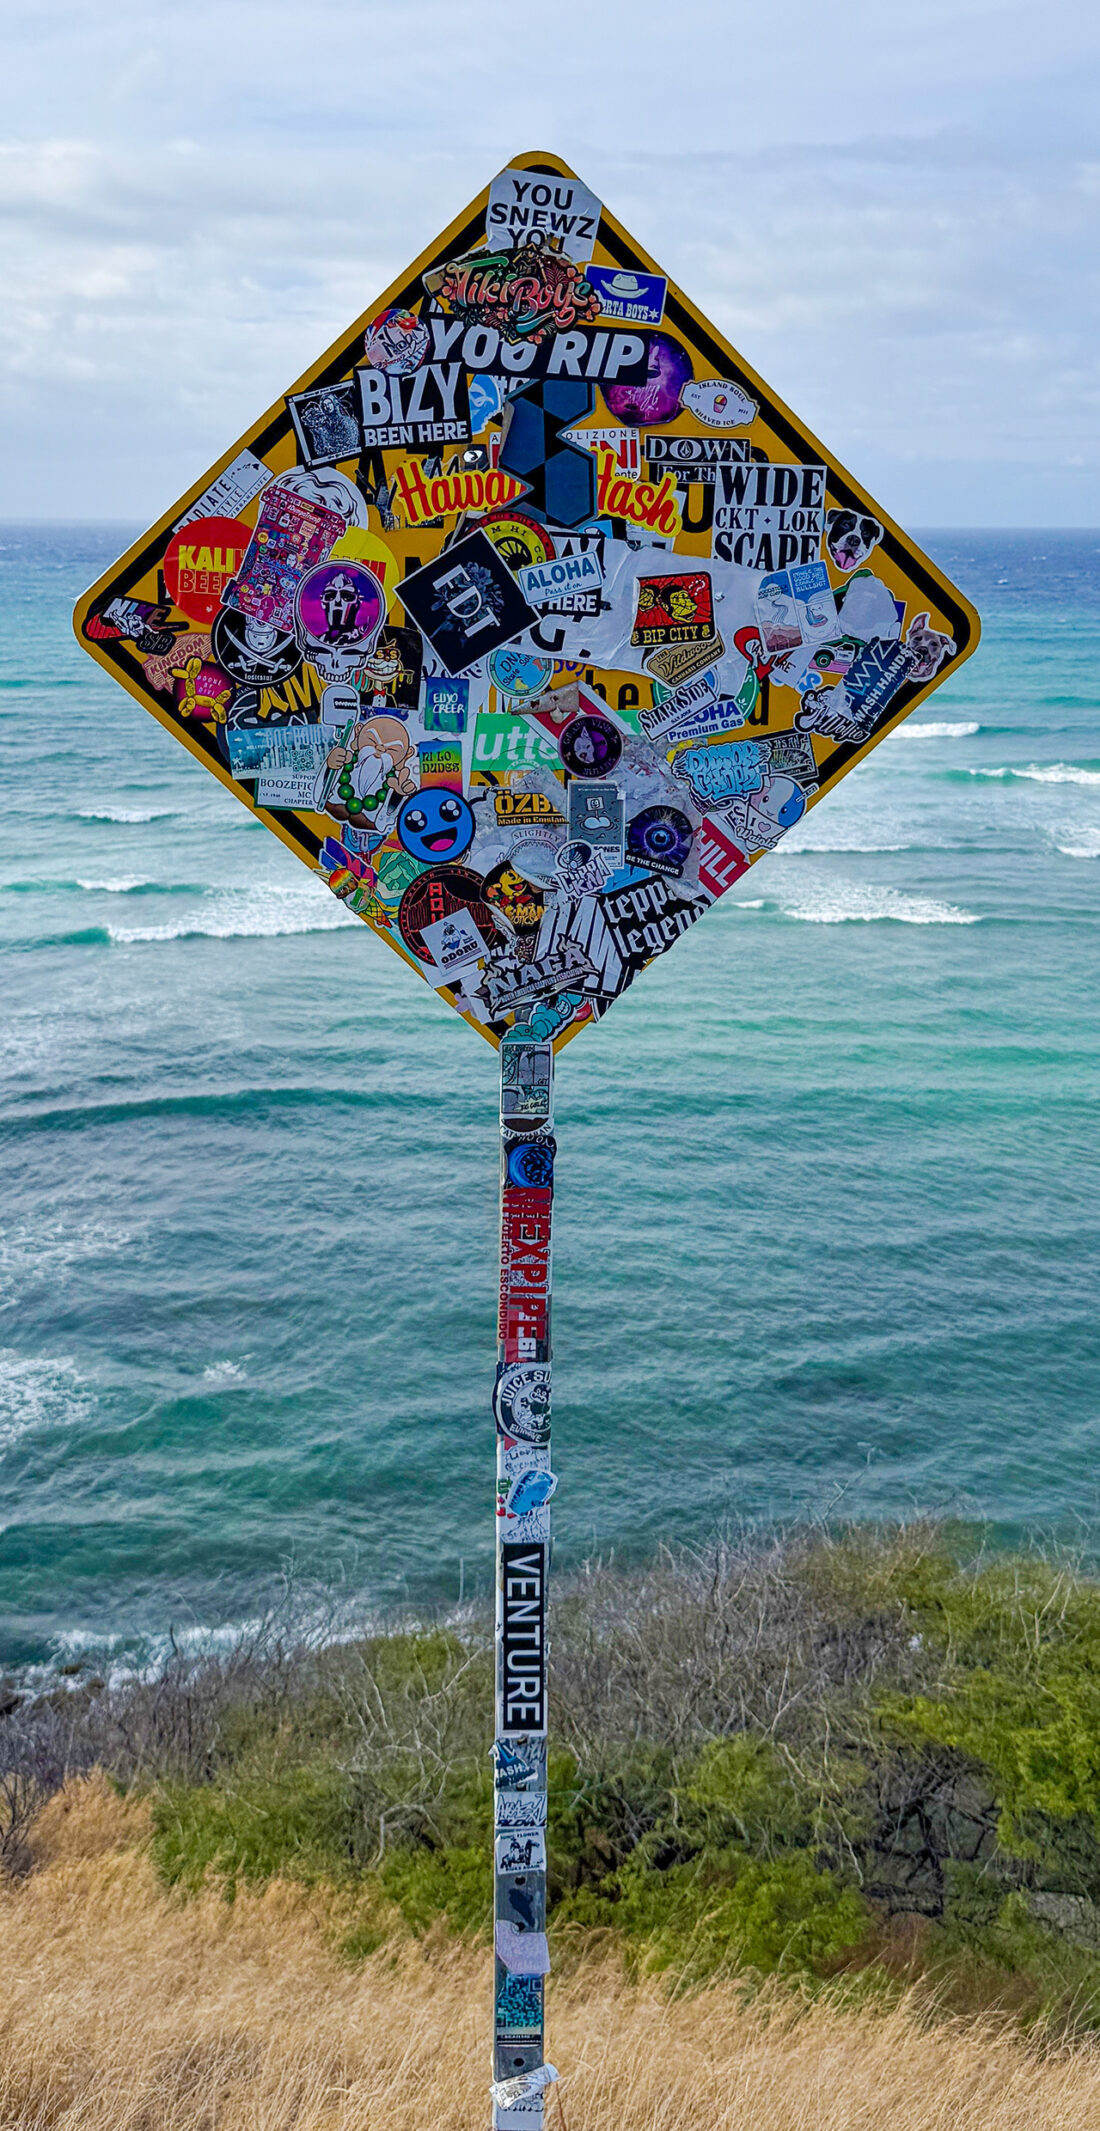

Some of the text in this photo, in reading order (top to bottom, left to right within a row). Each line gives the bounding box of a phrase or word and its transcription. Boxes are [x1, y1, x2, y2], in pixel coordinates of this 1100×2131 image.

[512, 179, 573, 210] YOU
[489, 202, 595, 240] SNEWZ
[625, 303, 650, 321] BOYS
[430, 318, 645, 379] YOU RIP
[357, 361, 463, 427] BIZY
[699, 381, 746, 402] ISLAND SOUL
[694, 408, 721, 425] SHAVED
[364, 420, 469, 447] BEEN HERE
[648, 437, 748, 462] DOWN
[694, 467, 716, 481] Th
[719, 465, 825, 509] WIDE
[178, 477, 232, 532] ADIATE
[396, 461, 528, 523] Hawai
[713, 531, 820, 573] SCAPE
[526, 557, 596, 591] ALOHA
[643, 625, 699, 644] BIP CITY
[150, 638, 205, 675] KINGDOM
[658, 640, 712, 678] Wildwoo
[695, 648, 721, 668] COMPANY
[853, 648, 909, 725] WASH HANDS
[432, 703, 465, 714] CREER
[639, 678, 709, 729] SHARKSIDE
[678, 701, 742, 729] LOHA
[668, 716, 744, 742] Premium Gas
[422, 762, 460, 774] DUDES
[284, 798, 314, 807] CHAPTER
[297, 790, 312, 800] MC
[494, 791, 557, 814] ÖZB
[497, 817, 521, 826] Made
[513, 829, 560, 842] SLIGHTLY
[637, 857, 651, 866] THE
[651, 862, 680, 876] CHANGE
[440, 942, 479, 964] ODORU
[486, 947, 588, 1000] NAGA
[498, 1269, 511, 1340] ESCONDIDO
[501, 1371, 532, 1407] JUICE
[507, 1552, 541, 1723] VENTURE
